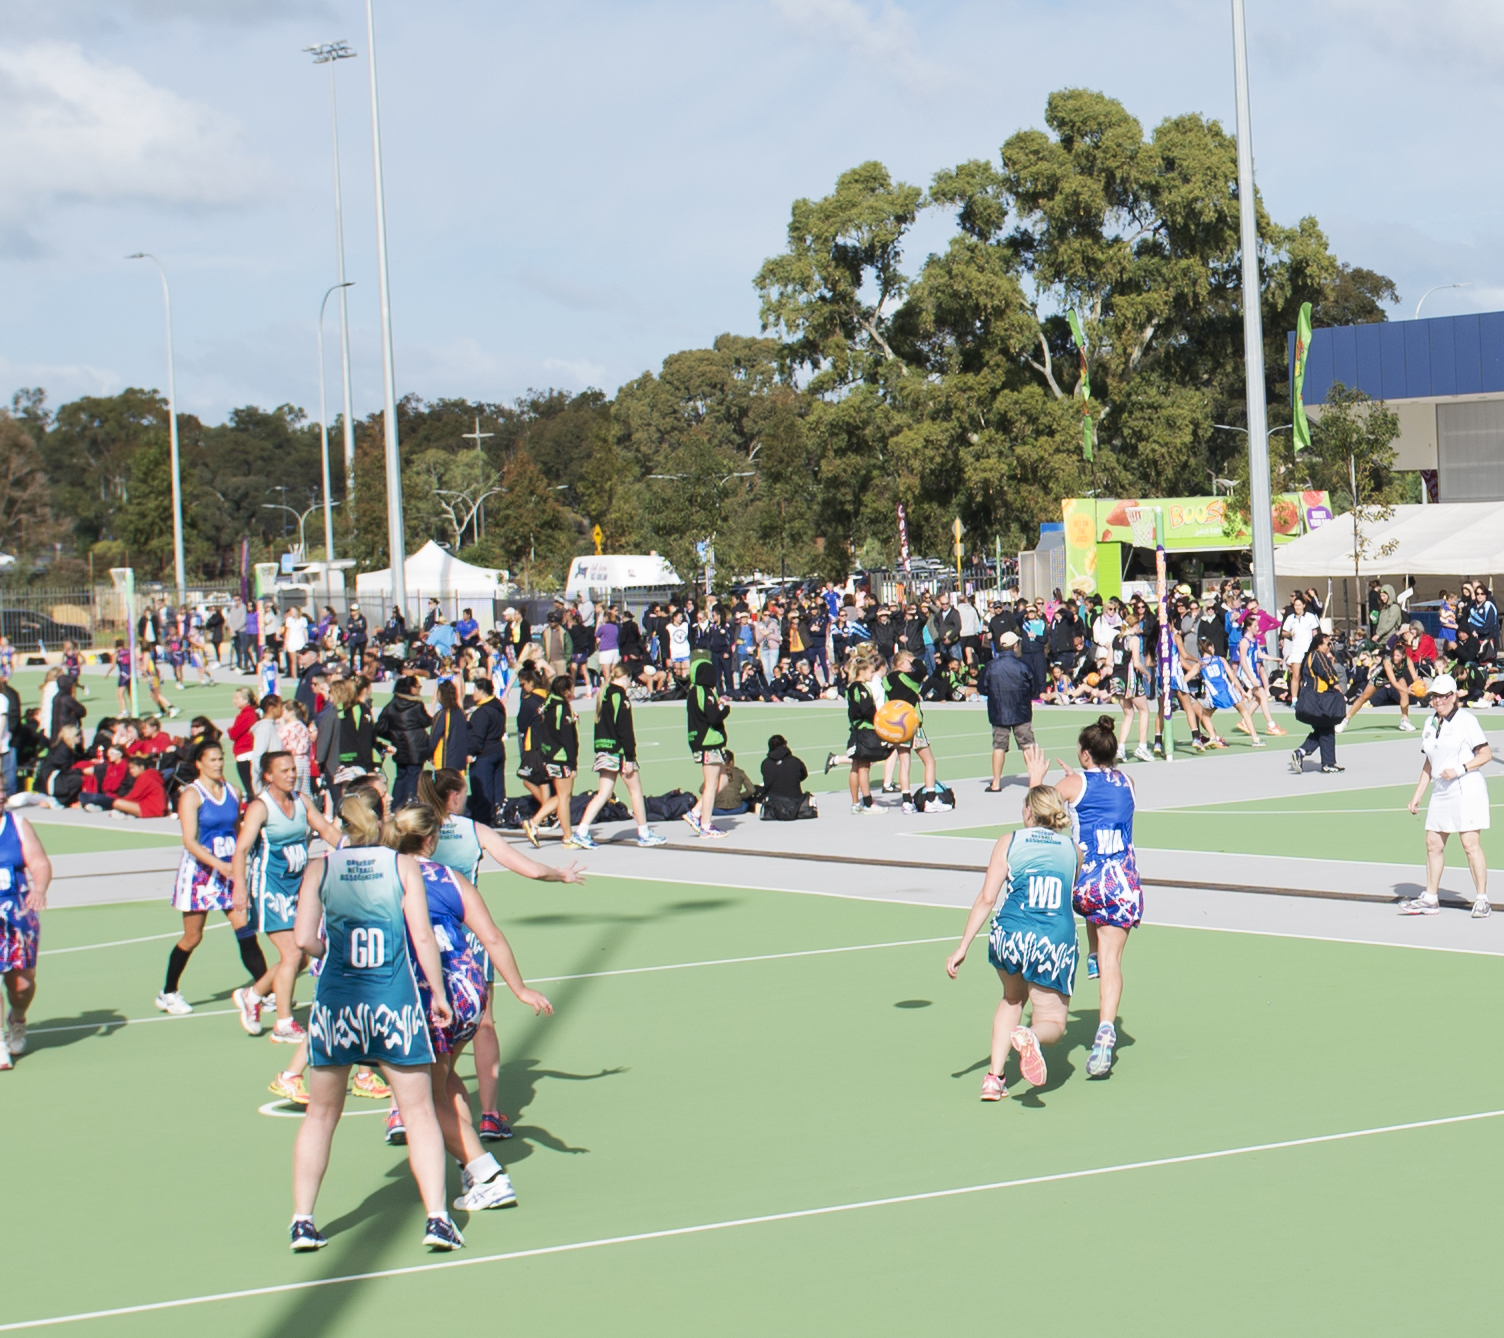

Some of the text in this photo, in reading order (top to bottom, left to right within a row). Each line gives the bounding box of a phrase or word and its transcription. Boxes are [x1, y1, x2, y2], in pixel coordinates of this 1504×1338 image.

[1096, 829, 1125, 854] WA
[1028, 875, 1063, 909] WD
[351, 927, 385, 969] GD
